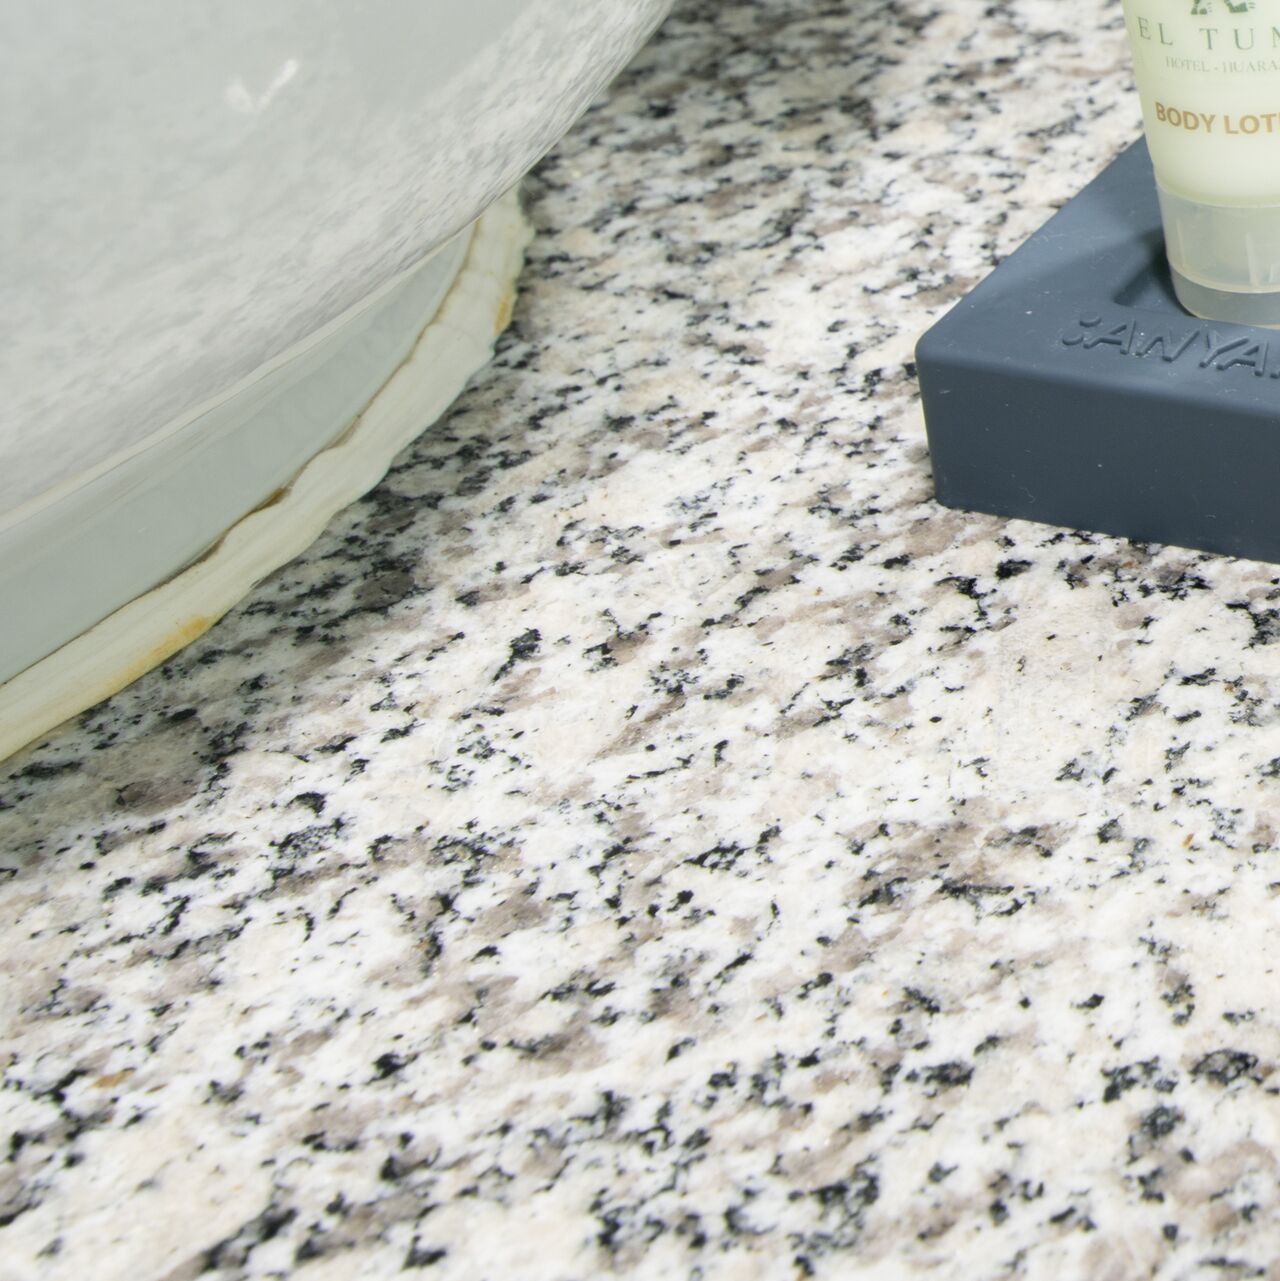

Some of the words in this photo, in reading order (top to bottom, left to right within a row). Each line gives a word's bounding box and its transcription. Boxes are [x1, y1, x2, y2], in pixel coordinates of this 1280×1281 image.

[1137, 16, 1173, 46] EL
[1165, 55, 1211, 73] HOTEL
[1154, 101, 1216, 133] BODY
